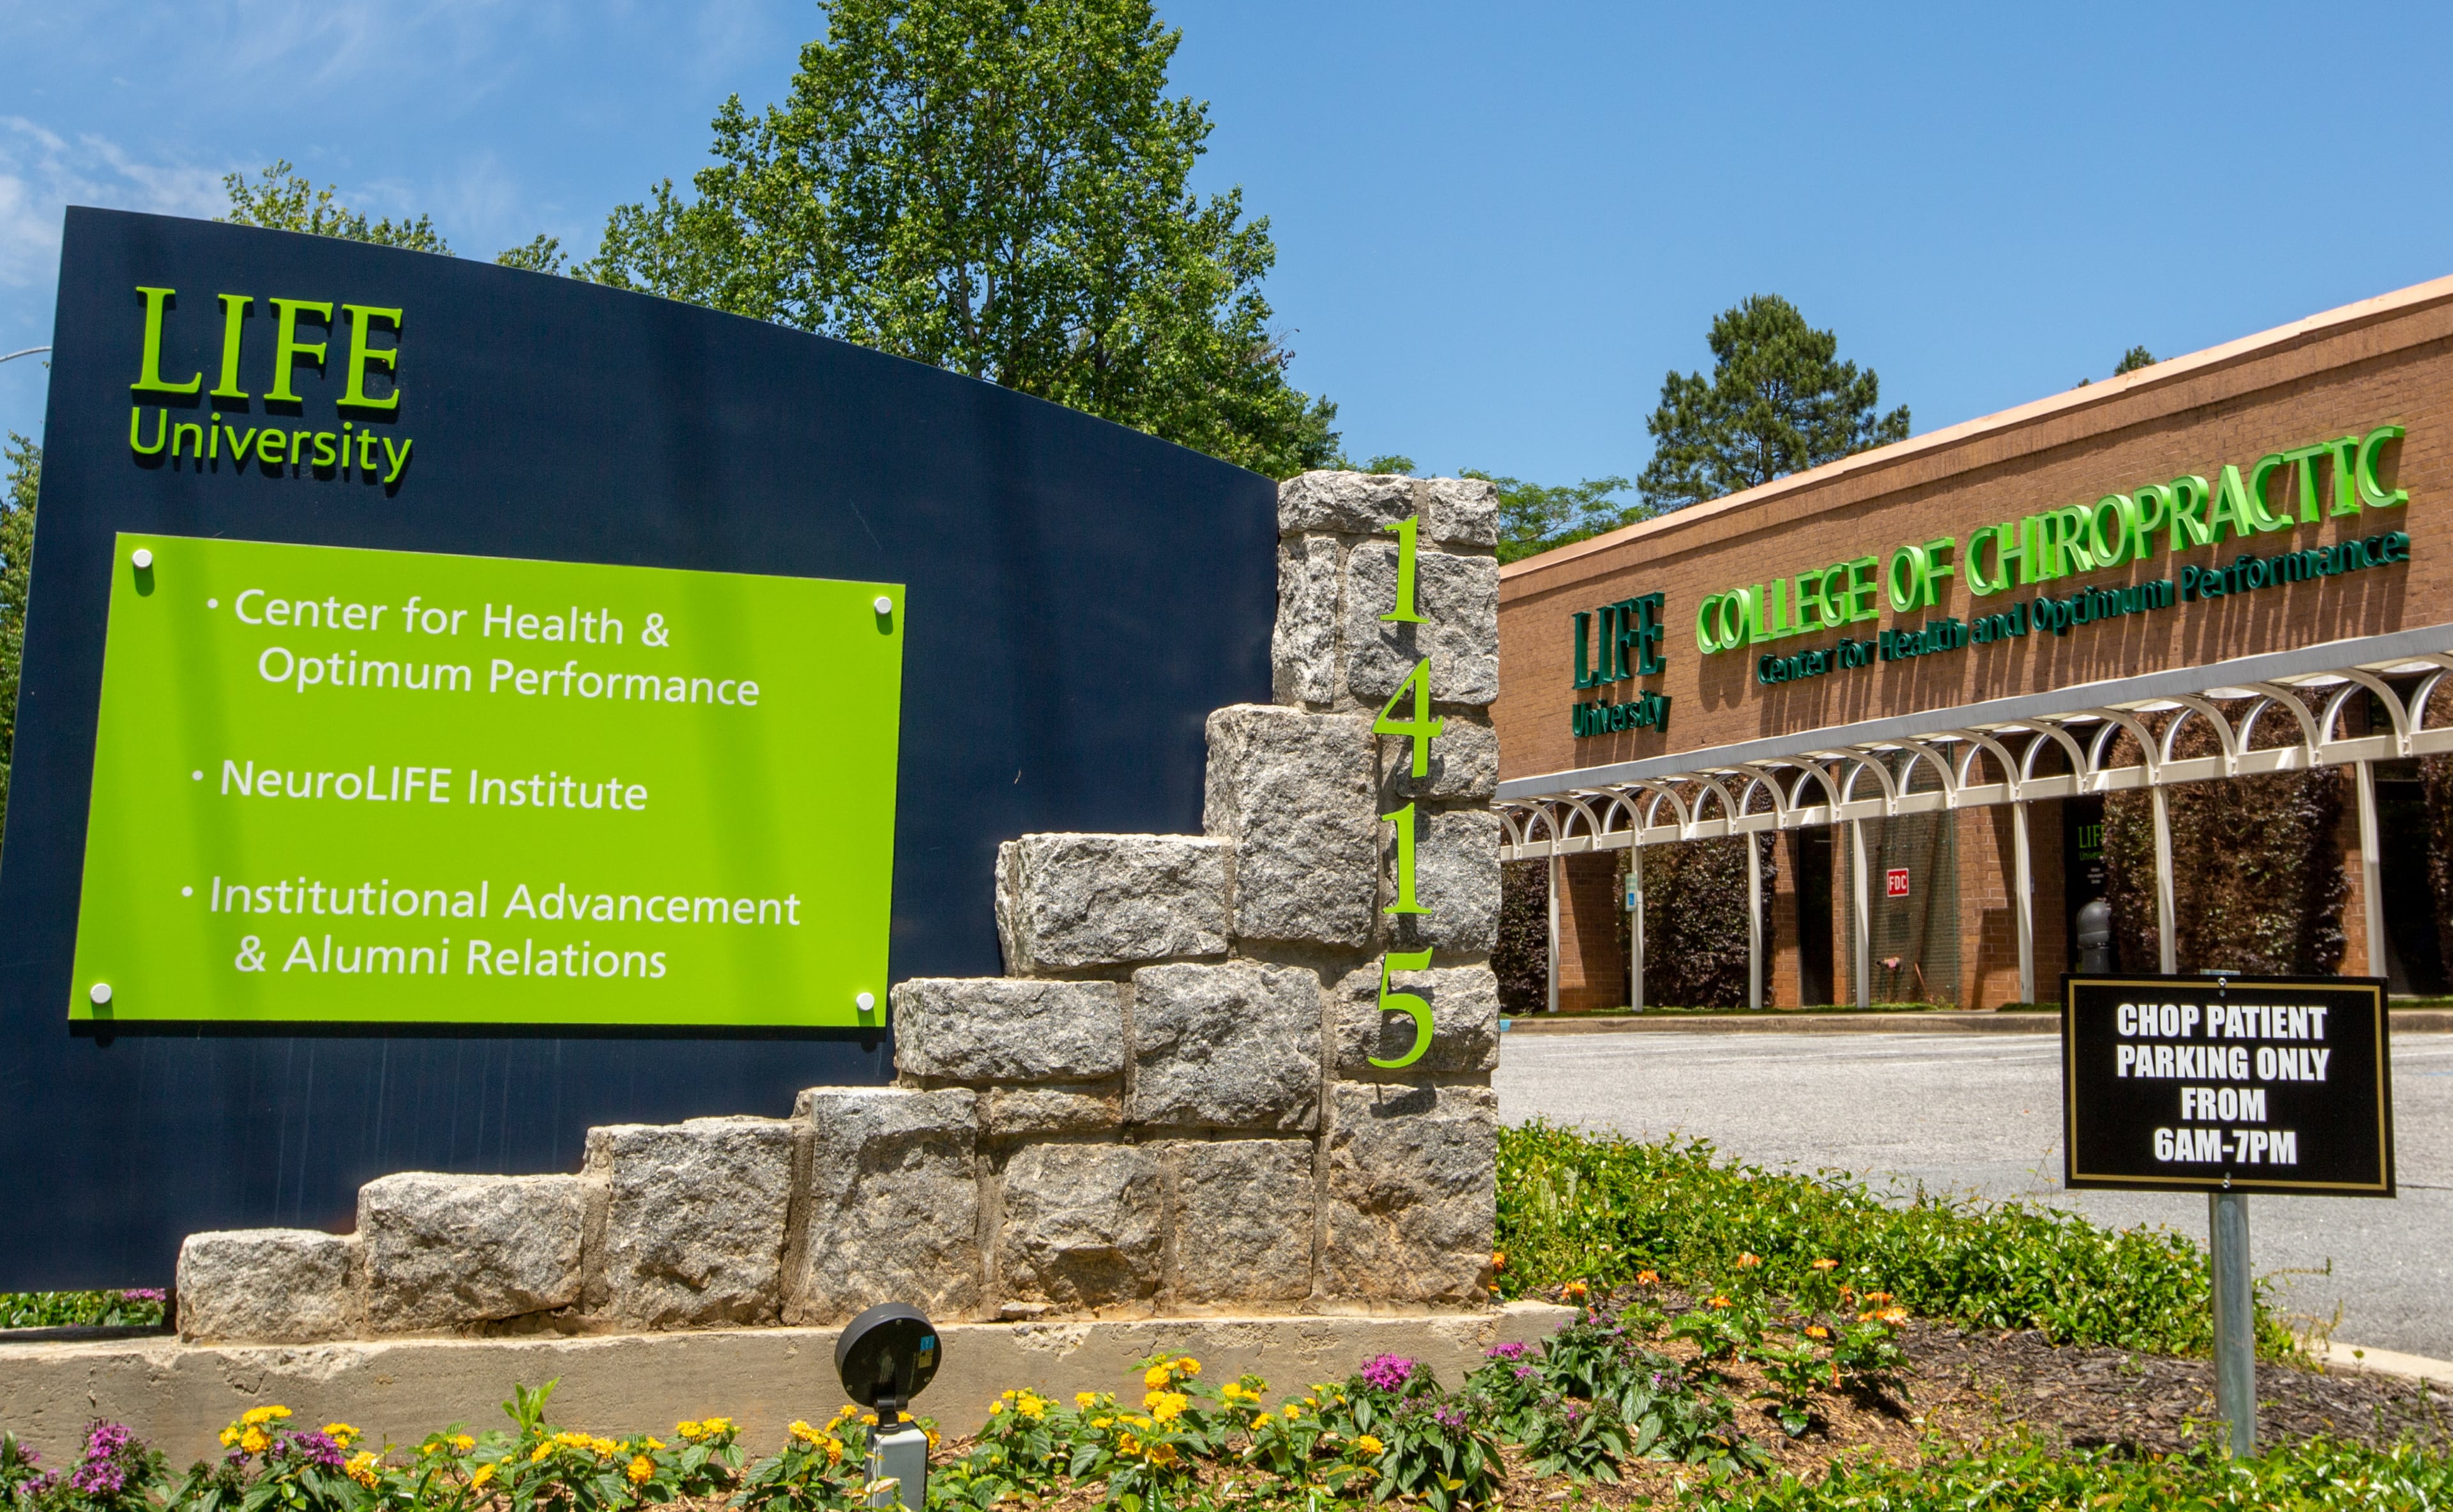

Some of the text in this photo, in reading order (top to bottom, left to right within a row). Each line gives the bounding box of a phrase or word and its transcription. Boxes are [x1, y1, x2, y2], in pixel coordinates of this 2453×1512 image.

[130, 286, 403, 409] LIFE
[130, 406, 413, 483] University
[1696, 425, 2409, 655] COLLEGE OF CHIROPRACTIC
[235, 588, 669, 647] Center for Health &
[1757, 531, 2411, 685] Center for Health and Optimum Performance
[1571, 592, 1666, 690] LIFE
[258, 646, 760, 706] Optimum Performance
[1571, 690, 1672, 738] University
[221, 760, 648, 811] NeuroLIFE Institute
[211, 876, 801, 926] Institutional Advancement
[1889, 874, 1907, 891] FDC
[234, 934, 666, 979] & Alumni Relations
[2117, 1004, 2328, 1040] CHOP PATIENT
[2117, 1044, 2331, 1081] PARKING ONLY
[2182, 1087, 2267, 1122] FROM
[2154, 1127, 2298, 1165] 6AM-7PM
